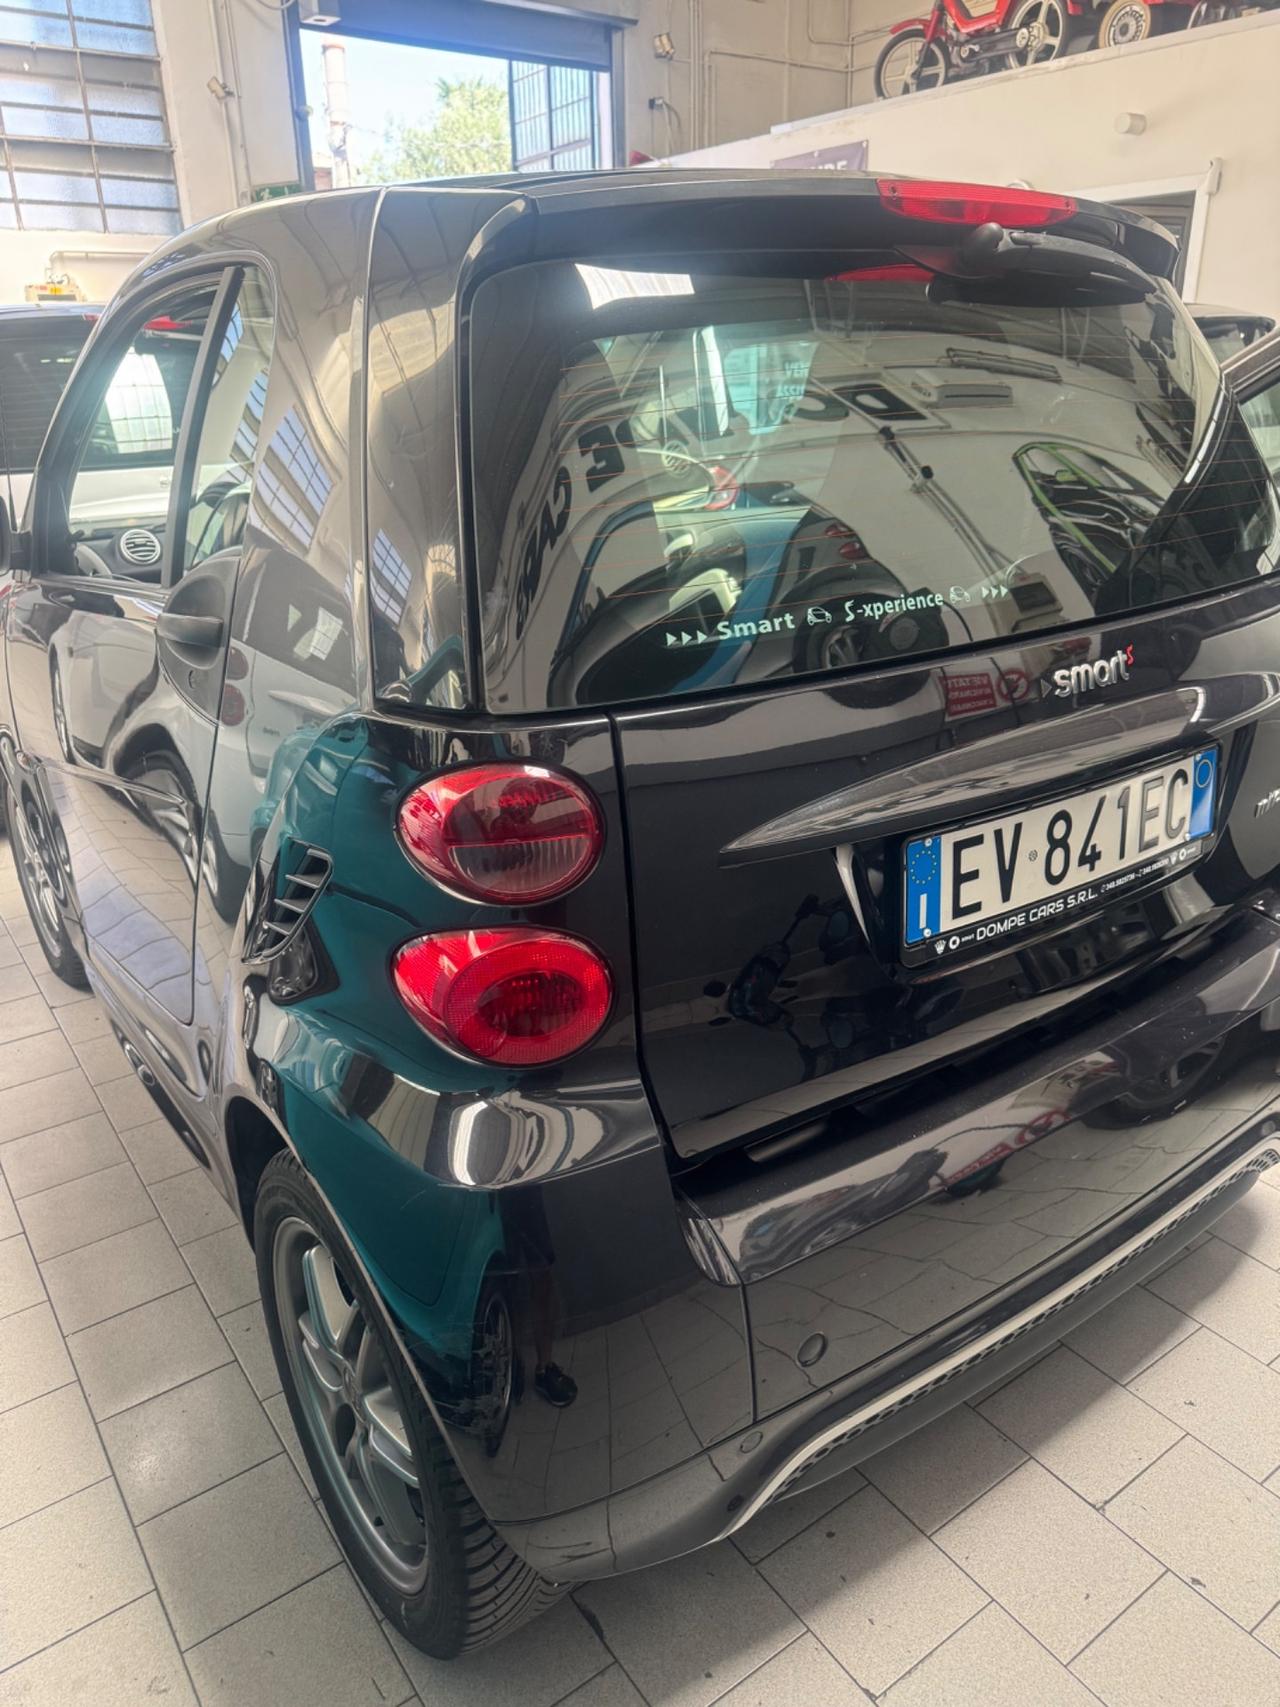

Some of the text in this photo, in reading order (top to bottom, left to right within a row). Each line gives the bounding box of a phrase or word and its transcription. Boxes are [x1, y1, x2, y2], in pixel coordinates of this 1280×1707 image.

[716, 592, 944, 641] Smart S-xperience
[1054, 650, 1130, 697] smart
[952, 768, 1189, 919] EV 841EC
[976, 913, 1026, 941] DOMPE
[1029, 899, 1064, 922] CARS
[1067, 887, 1098, 909] S.R.L.
